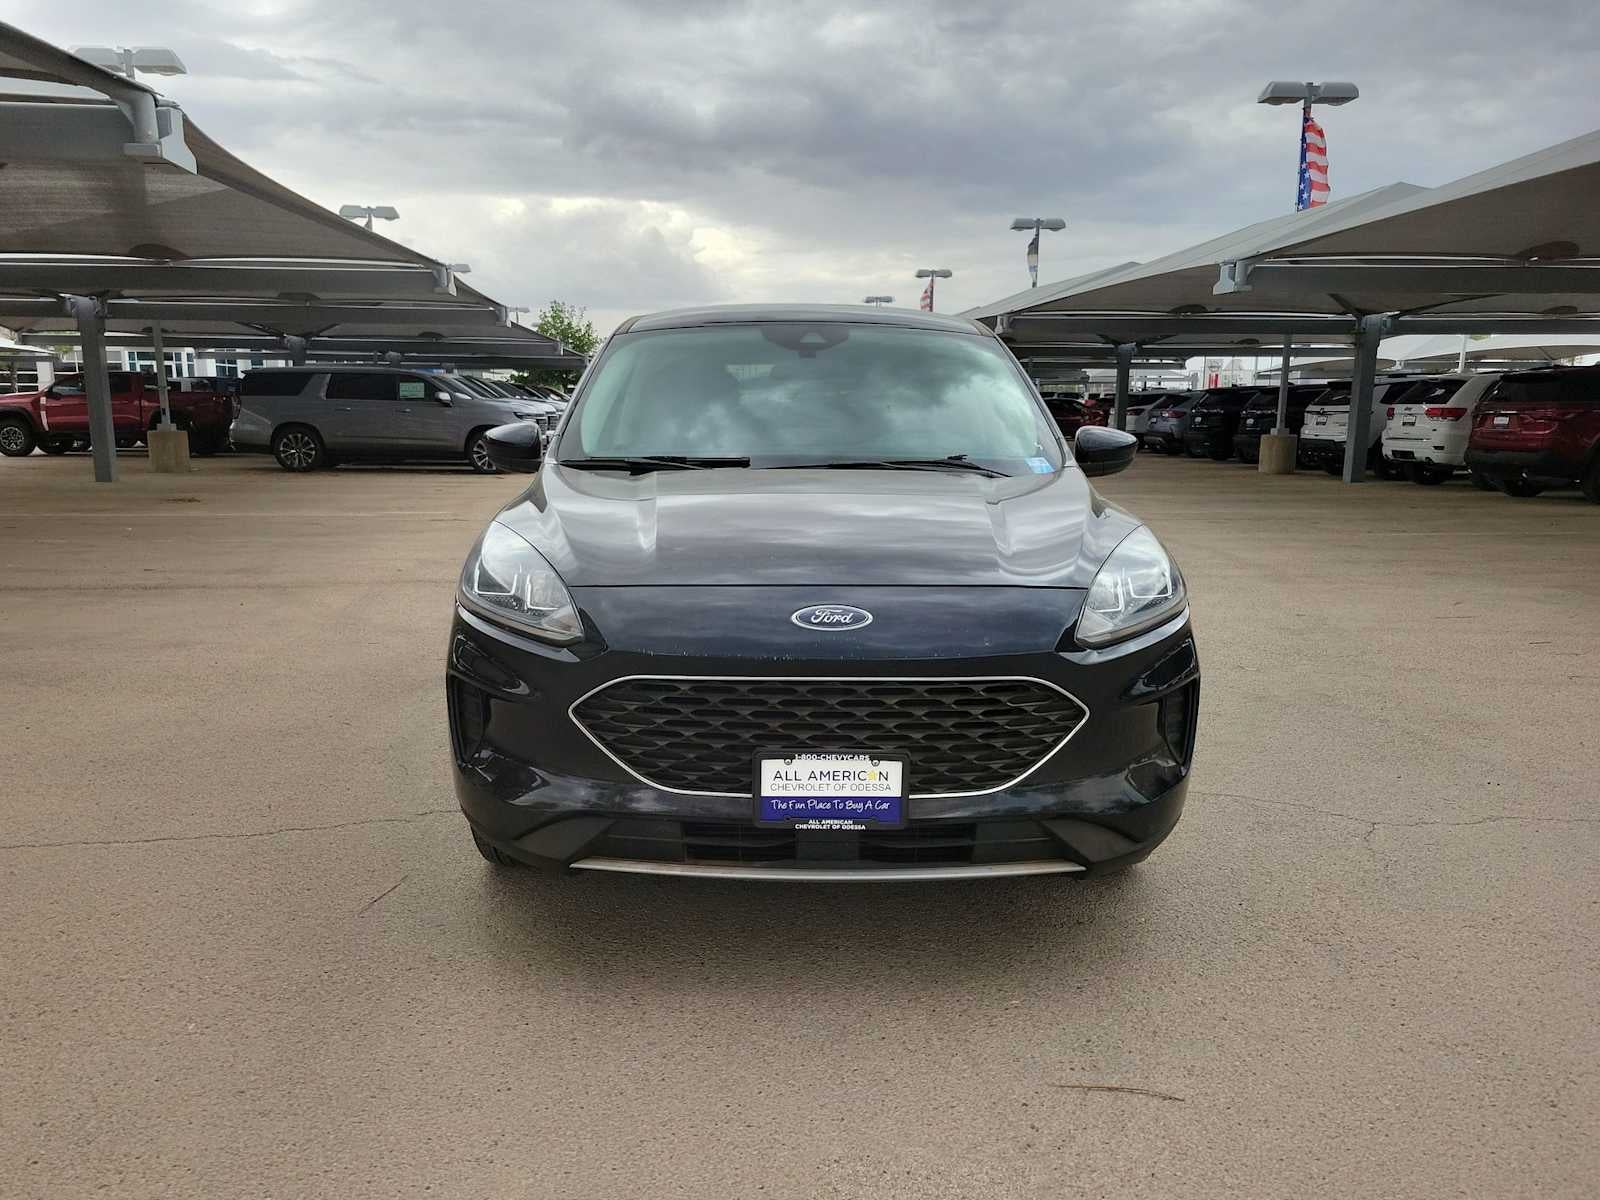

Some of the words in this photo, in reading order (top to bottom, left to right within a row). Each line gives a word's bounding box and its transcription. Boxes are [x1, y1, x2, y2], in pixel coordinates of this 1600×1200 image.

[811, 609, 854, 623] Ford
[773, 770, 802, 781] ALL
[770, 783, 831, 791] CHEVROLET
[833, 783, 847, 791] OF
[850, 783, 891, 791] ODESSA
[771, 800, 787, 810] The
[789, 800, 806, 810] Fun
[806, 800, 832, 810] Place
[833, 800, 844, 810] To
[846, 800, 863, 812] Buy
[865, 800, 873, 809] A
[874, 800, 890, 810] Car
